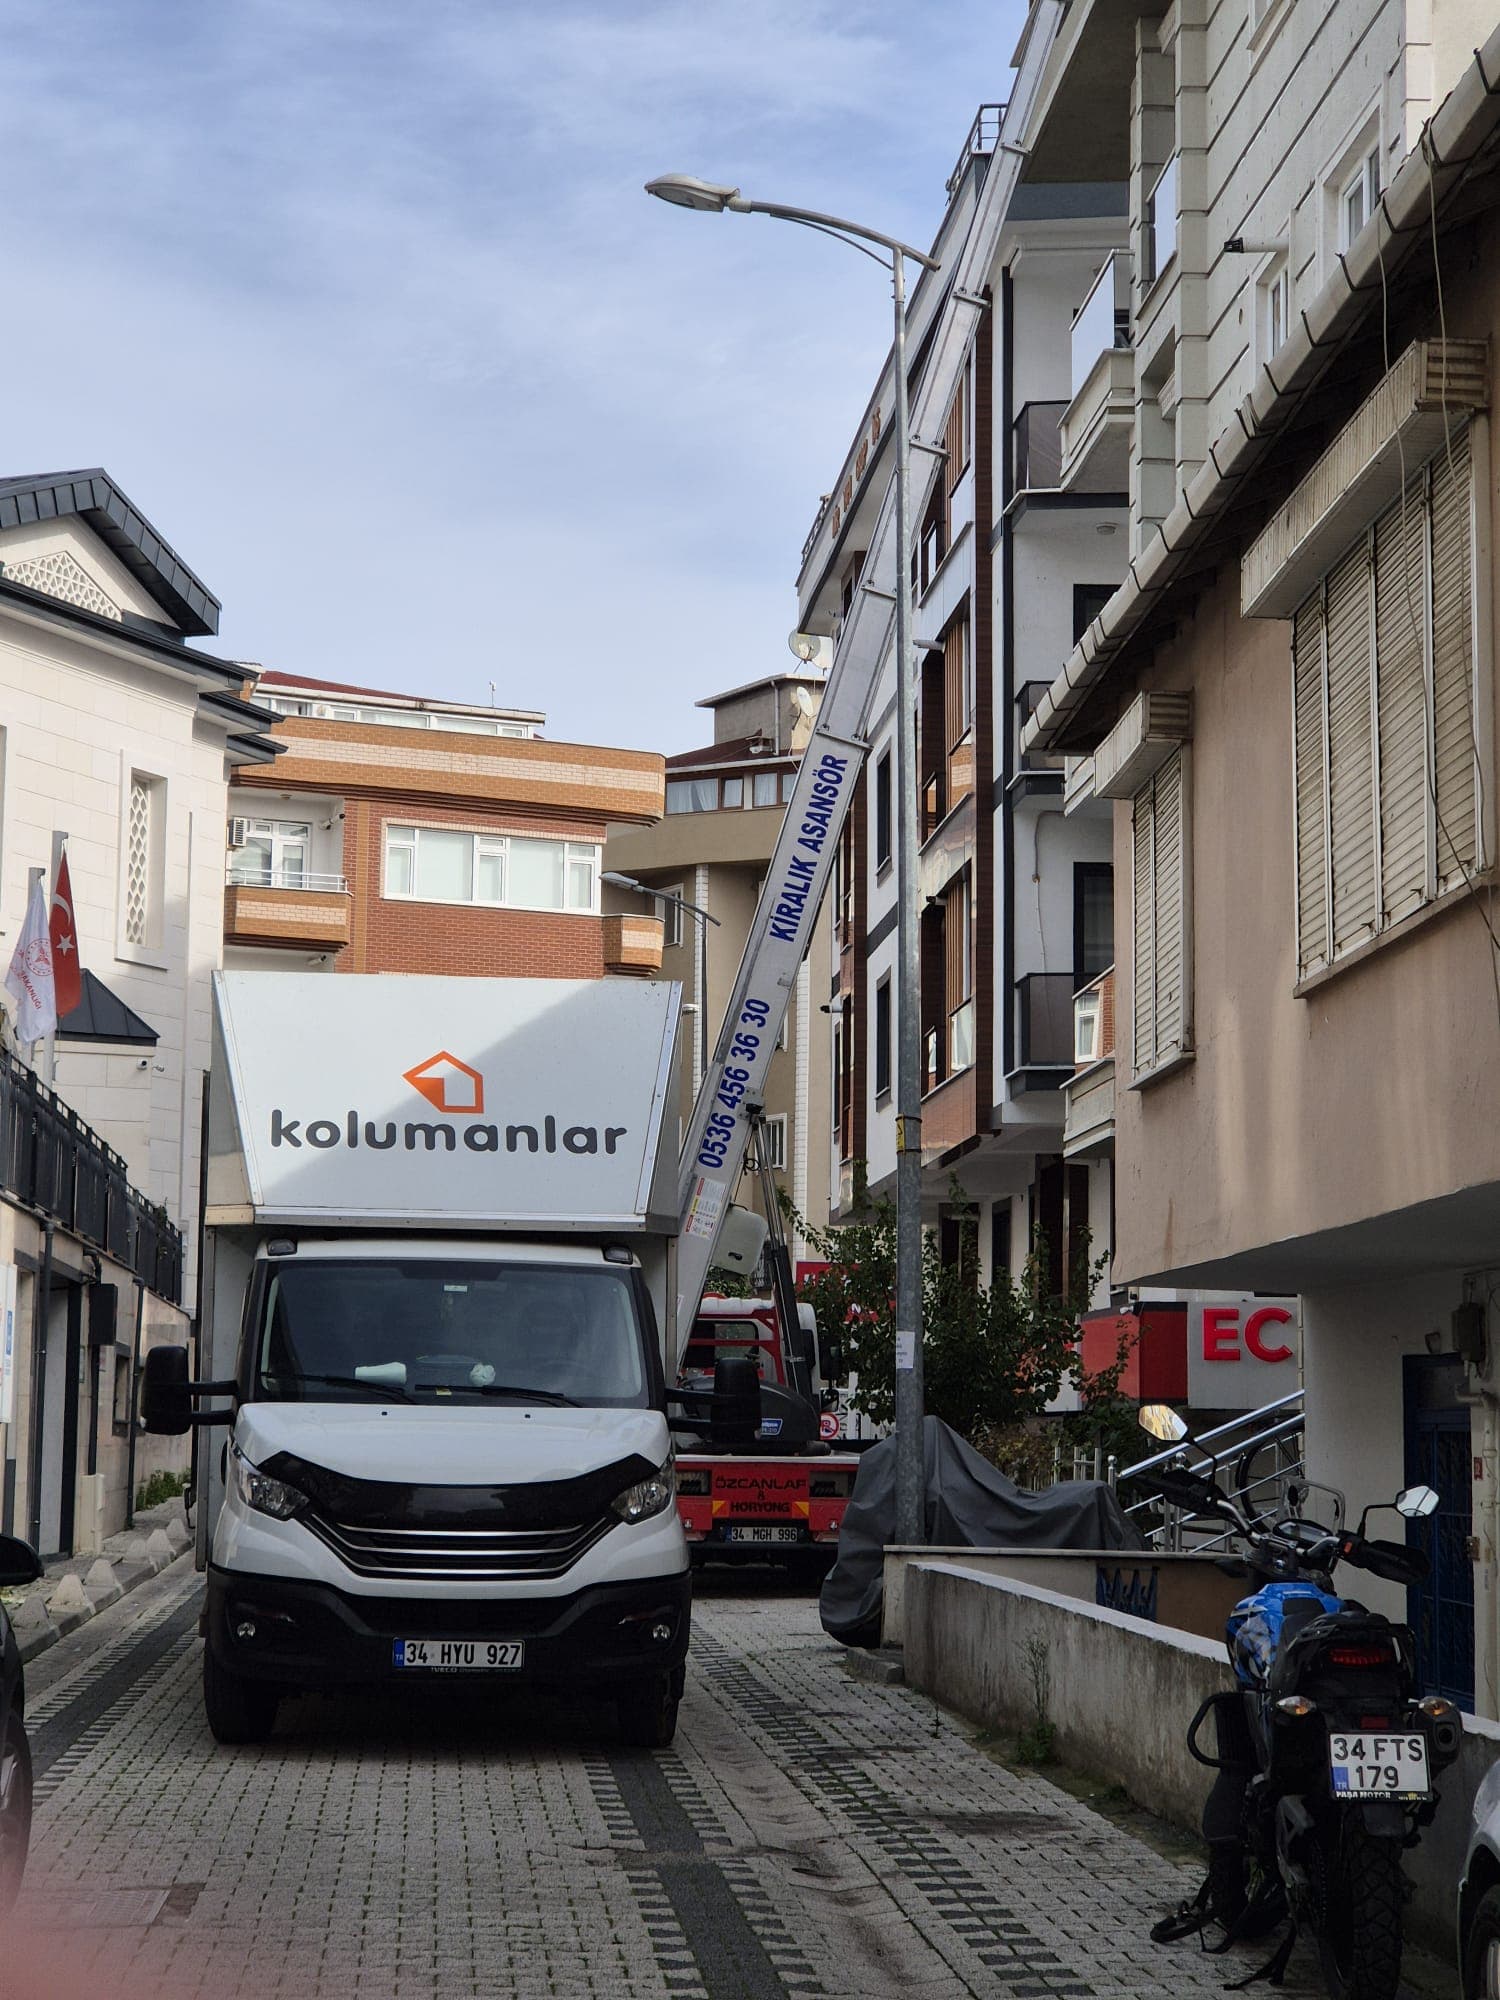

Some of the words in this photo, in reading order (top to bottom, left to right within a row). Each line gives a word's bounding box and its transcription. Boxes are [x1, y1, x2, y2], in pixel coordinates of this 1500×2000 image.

[769, 855, 818, 943] KİRALIK
[797, 754, 849, 854] ASANSÖR
[740, 998, 770, 1028] 30
[730, 1032, 760, 1062] 36
[717, 1066, 750, 1110] 456
[271, 1108, 628, 1154] kolumanlar
[698, 1112, 736, 1169] 0536
[730, 1501, 790, 1513] HORYONG
[732, 1528, 745, 1540] 34
[752, 1528, 772, 1541] MGH
[779, 1528, 798, 1541] 996
[406, 1643, 428, 1664] 34
[440, 1643, 475, 1664] HYU
[486, 1644, 520, 1665] 927
[1333, 1737, 1366, 1761] 34
[1373, 1738, 1423, 1762] FTS
[1337, 1782, 1347, 1790] TR
[1356, 1765, 1399, 1789] 179
